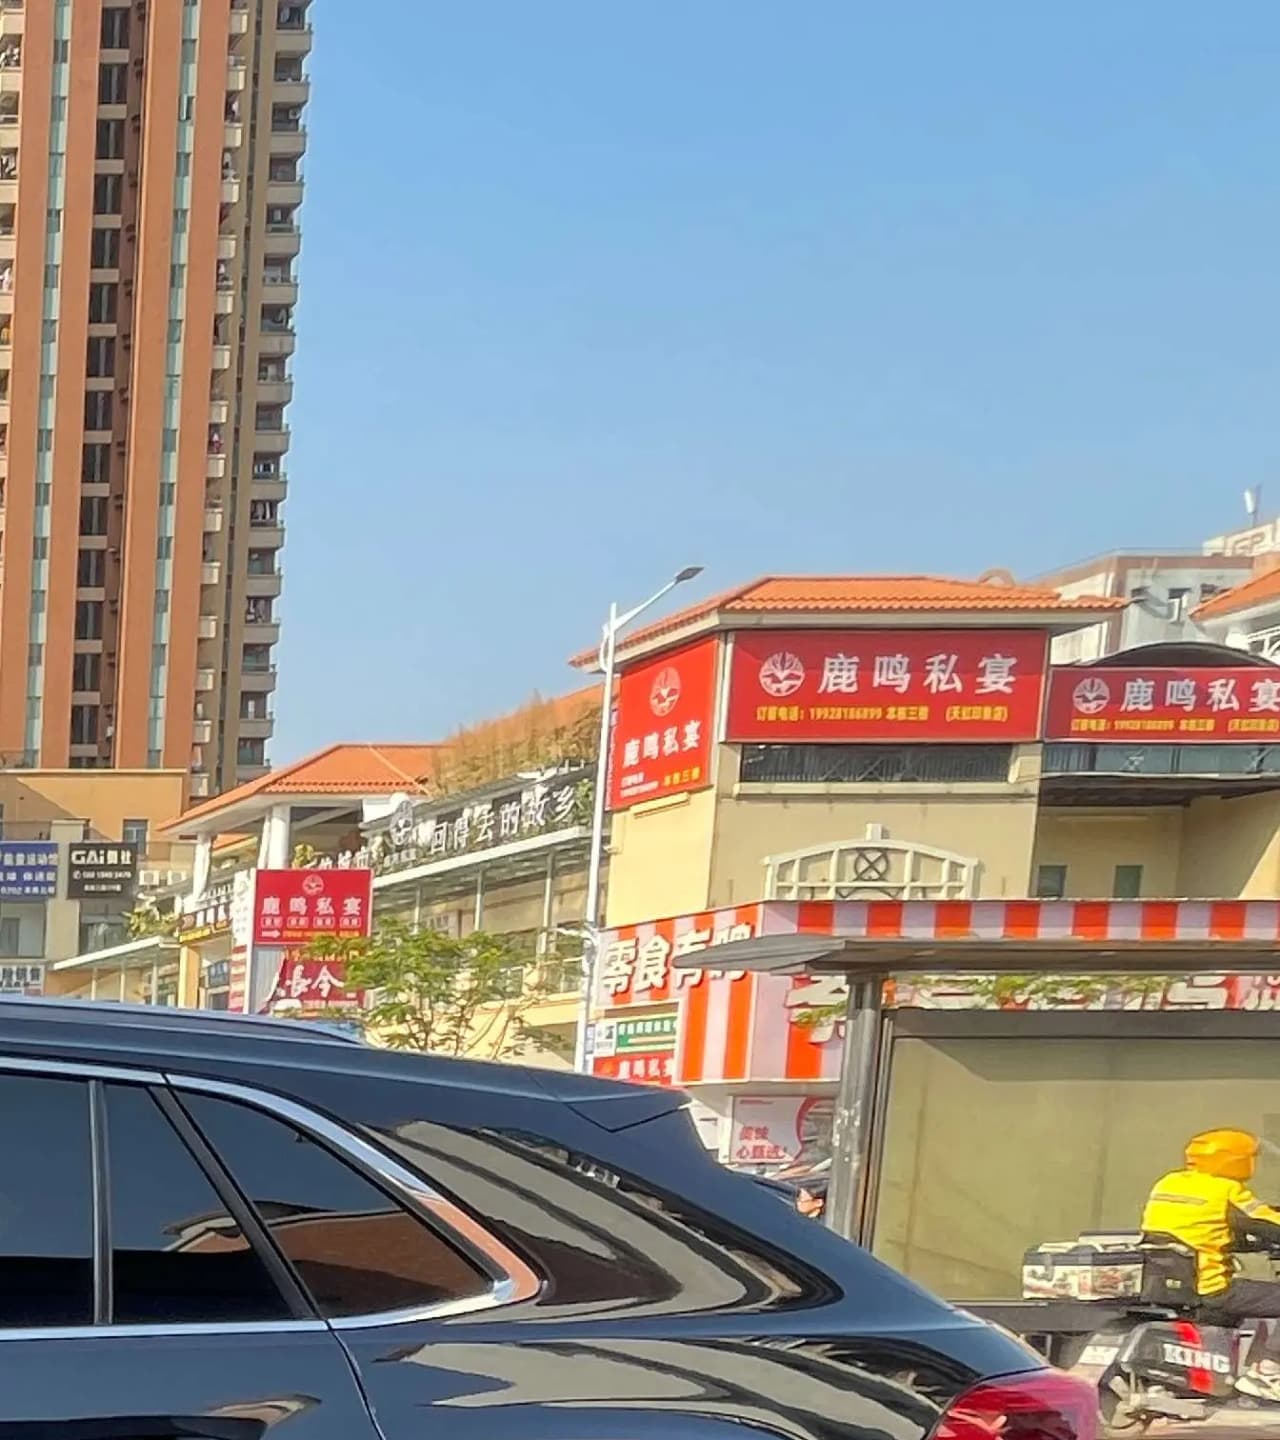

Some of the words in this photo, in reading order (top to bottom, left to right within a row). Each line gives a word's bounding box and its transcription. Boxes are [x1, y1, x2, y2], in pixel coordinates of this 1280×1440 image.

[817, 653, 1018, 694] 鹿鸣私宴
[1120, 678, 1280, 712] 鹿鸣私宴
[261, 897, 362, 916] 鹿鸣私宴
